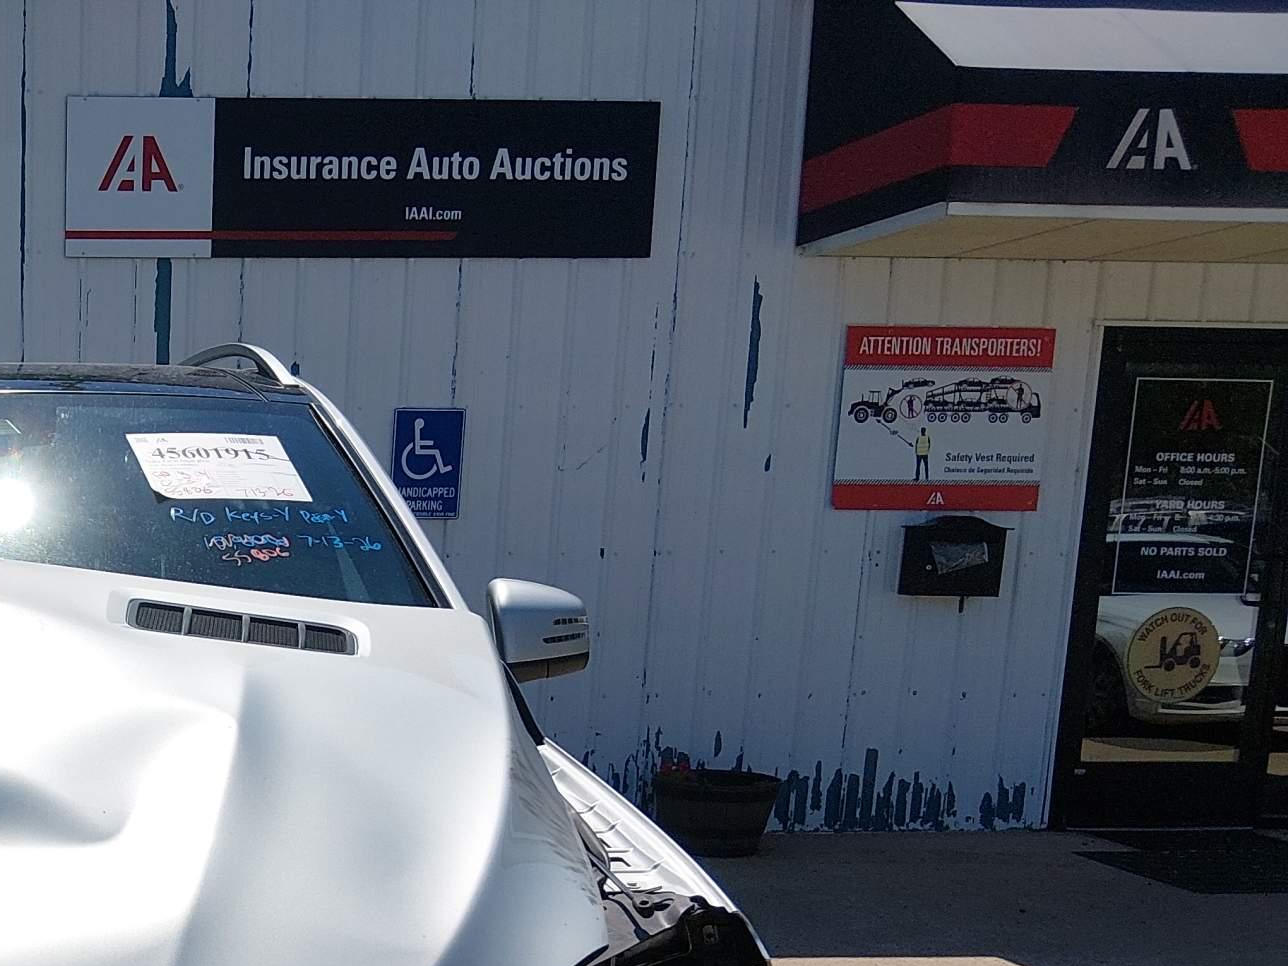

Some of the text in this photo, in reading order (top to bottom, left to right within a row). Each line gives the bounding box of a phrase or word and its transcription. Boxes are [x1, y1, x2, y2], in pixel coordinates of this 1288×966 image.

[243, 147, 629, 182] Insurance Auto Auctions
[404, 206, 462, 222] IAAI.com
[859, 336, 1042, 357] ATTENTION TRANSPORTERS!
[151, 446, 271, 461] 45601915
[944, 452, 1035, 465] Safety Vest Required
[1156, 452, 1236, 463] OFFICE HOURS
[1134, 465, 1152, 474] Mon
[1158, 466, 1168, 474] Fri
[1152, 478, 1168, 486] Sun
[1178, 478, 1203, 486] Closed
[1154, 500, 1226, 510] YARD HOURS
[169, 506, 216, 526] R/D
[1147, 525, 1162, 533] Sun
[1172, 525, 1198, 533] Closed
[298, 534, 382, 552] 7-13-26
[1140, 546, 1228, 557] NO PARTS SOLD
[1156, 569, 1206, 580] IAAI.com
[1137, 612, 1208, 643] WATCH OUT FOR
[1133, 663, 1211, 698] FORK LIFT TRUCKS
